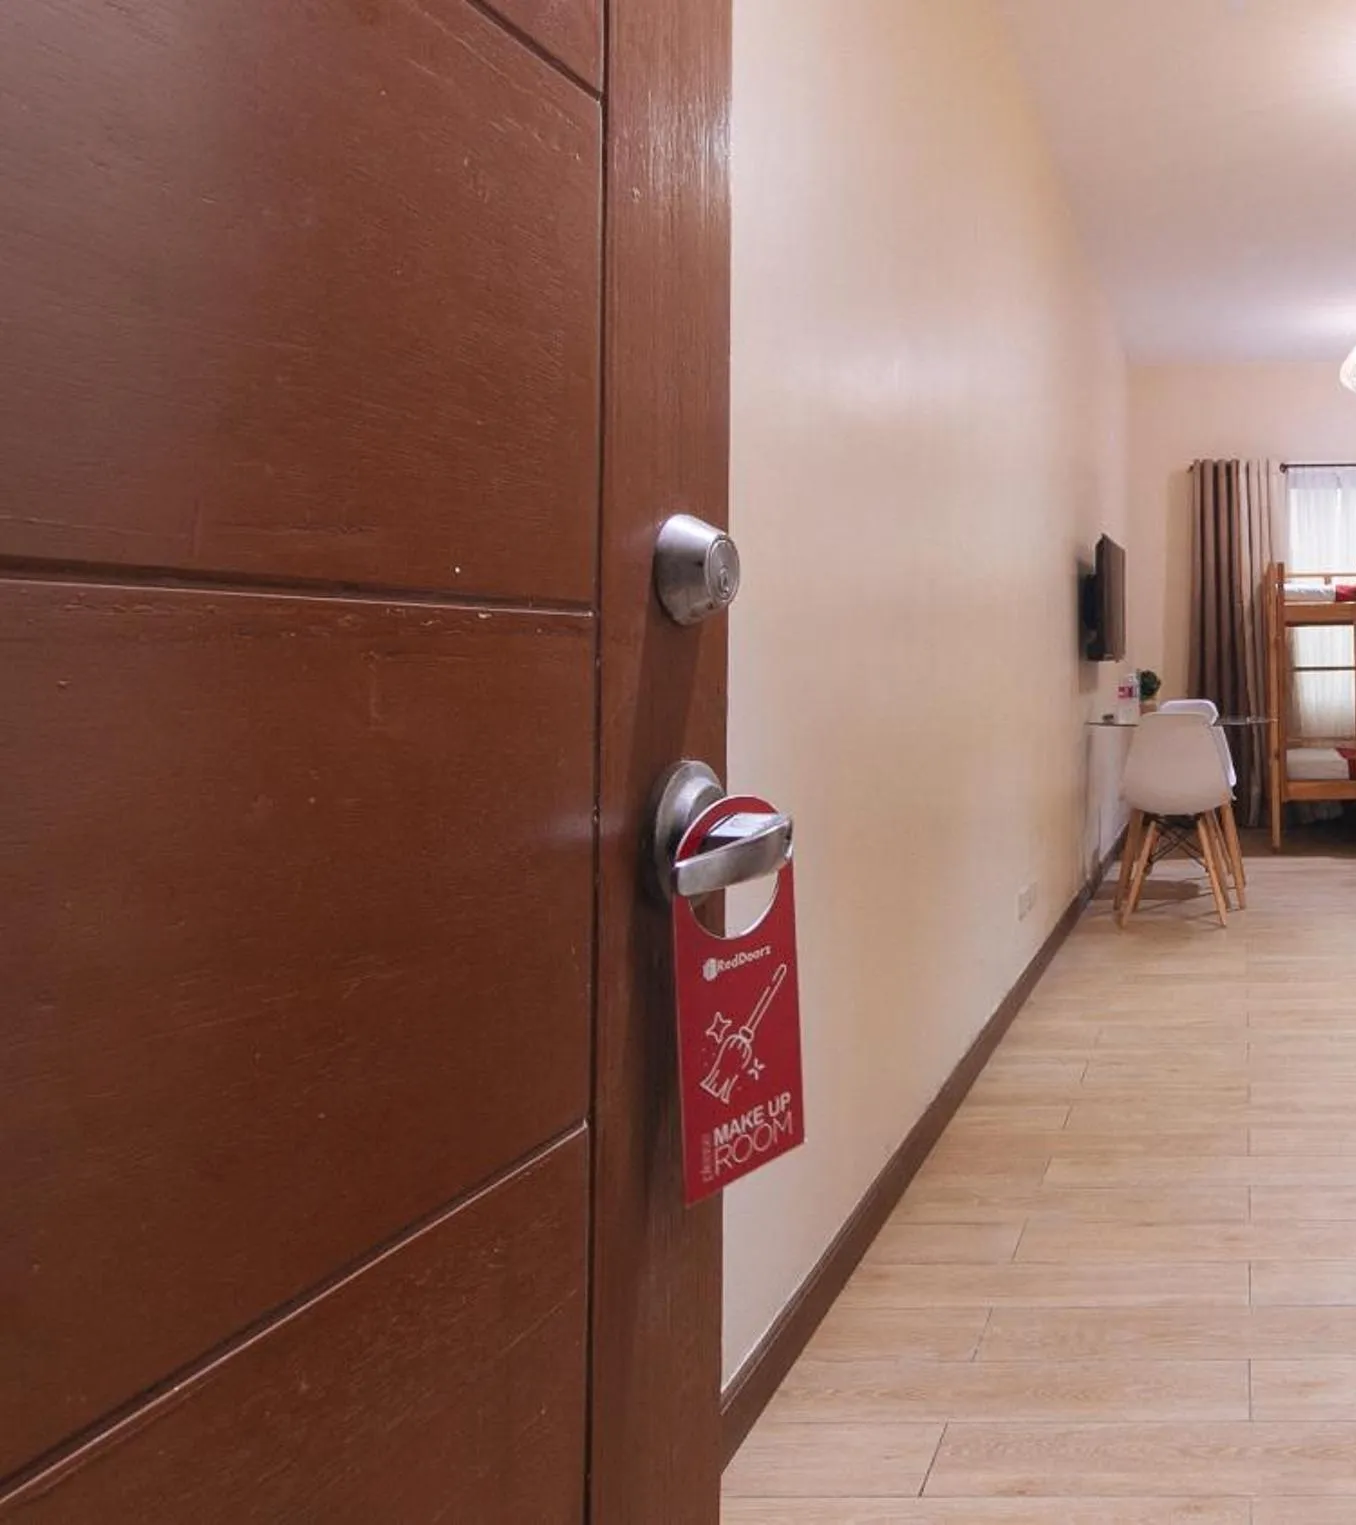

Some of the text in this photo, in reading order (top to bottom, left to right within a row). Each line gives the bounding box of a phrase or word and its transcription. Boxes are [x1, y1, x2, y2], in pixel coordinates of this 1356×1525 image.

[713, 1091, 791, 1146] MAKE UP
[715, 1110, 793, 1175] ROOM
